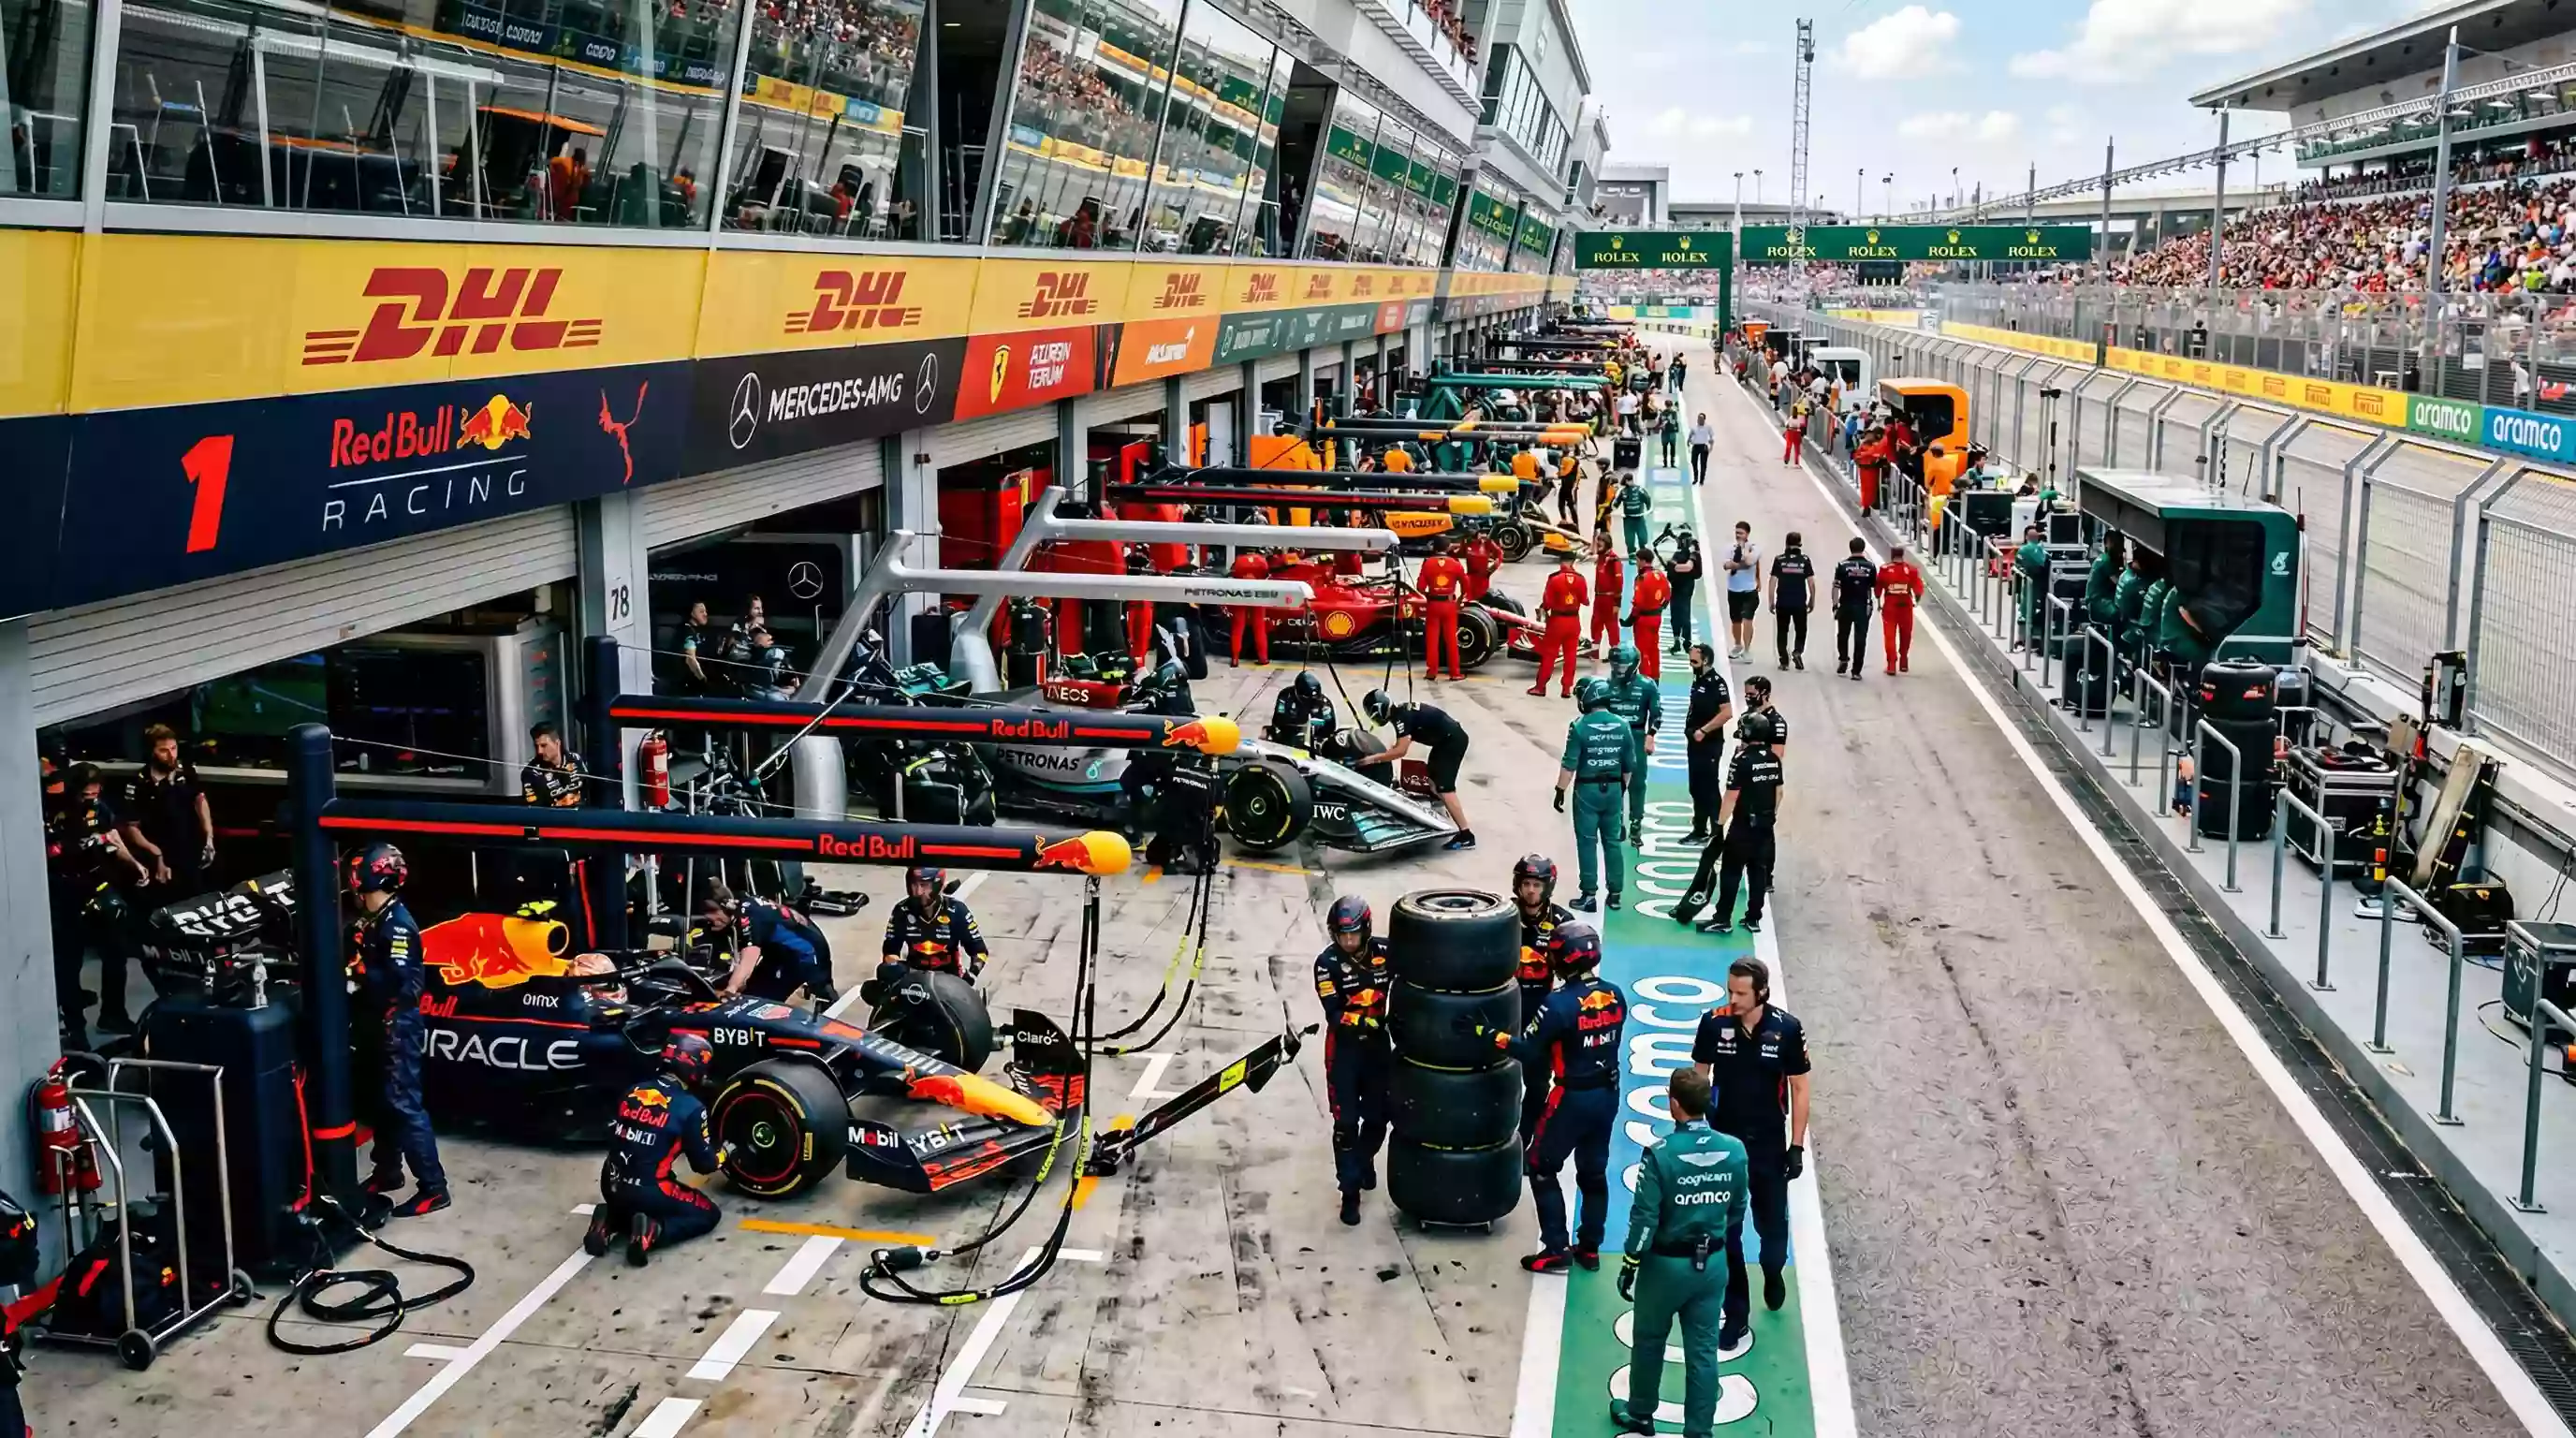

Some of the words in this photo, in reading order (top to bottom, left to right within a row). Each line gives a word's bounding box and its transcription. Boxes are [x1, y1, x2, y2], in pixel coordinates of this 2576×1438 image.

[1594, 252, 1640, 263] ROLEX
[1661, 252, 1708, 263] ROLEX
[1849, 246, 1897, 257] ROLEX
[1928, 246, 1977, 257] ROLEX
[2009, 246, 2057, 257] ROLEX
[807, 271, 907, 332] DHL
[1030, 272, 1090, 317] DHL
[1162, 273, 1202, 308] DHL
[352, 268, 564, 362] DHL
[768, 374, 904, 423] MERCEDES-AMG
[2415, 402, 2472, 434] aramco
[330, 412, 394, 467] Red
[395, 404, 454, 459] Bull
[2493, 414, 2562, 452] aramco
[181, 434, 234, 553] 1
[323, 469, 527, 532] RACING
[610, 584, 631, 622] 78
[1032, 720, 1069, 739] Bull
[997, 747, 1080, 771] PETRONAS
[1312, 804, 1345, 821] IWC
[818, 833, 865, 857] Red
[869, 835, 915, 858] Bull
[418, 991, 458, 1018] Bull
[421, 1028, 586, 1070] RACLE
[713, 1026, 766, 1048] BYBIT
[1017, 1030, 1056, 1045] Claro
[848, 1126, 899, 1148] Mobil
[1674, 1191, 1731, 1206] aramco
